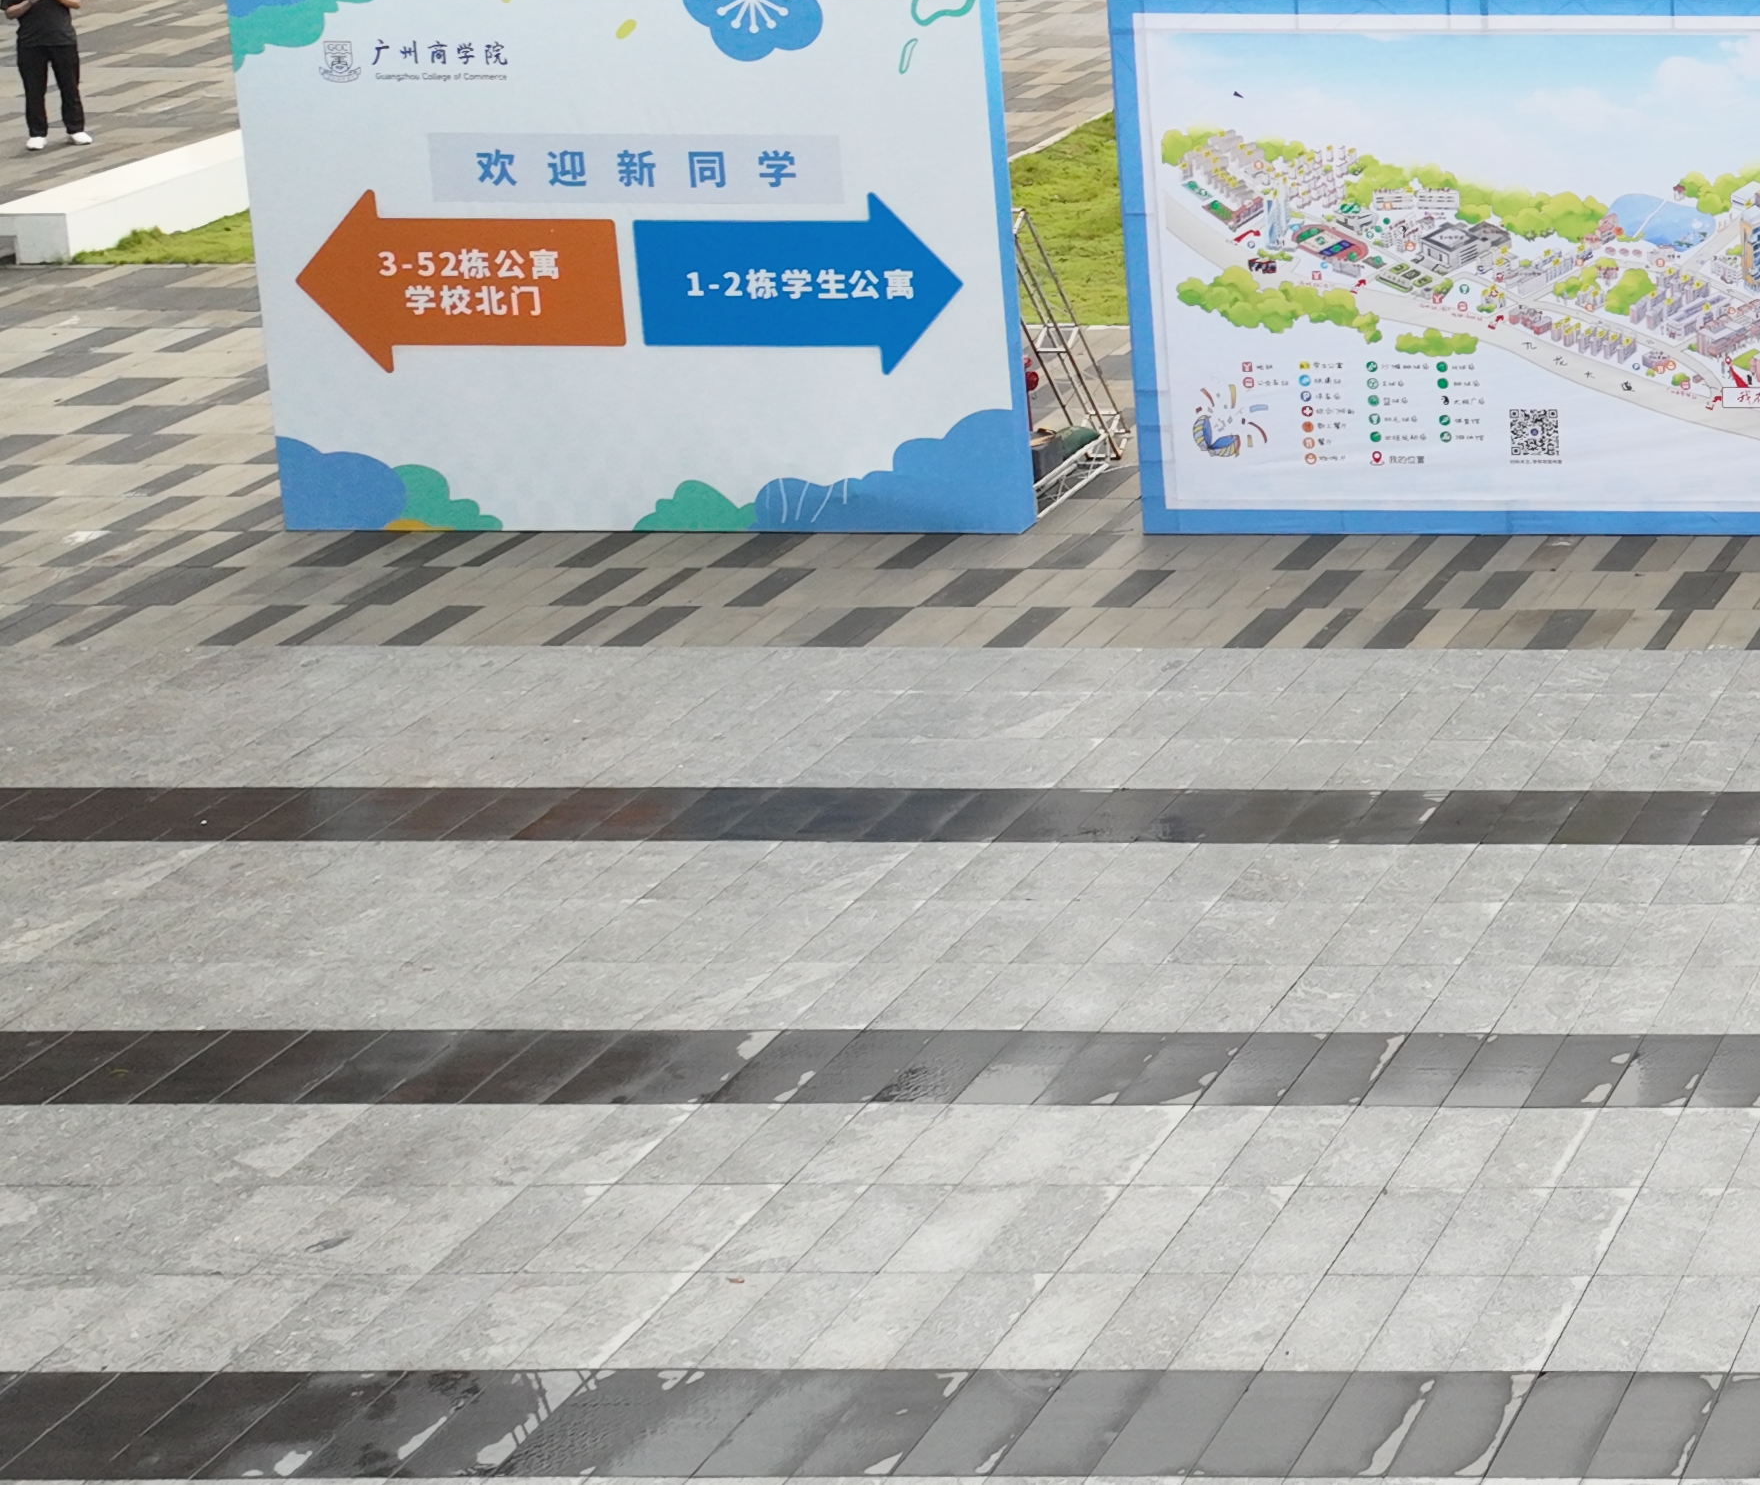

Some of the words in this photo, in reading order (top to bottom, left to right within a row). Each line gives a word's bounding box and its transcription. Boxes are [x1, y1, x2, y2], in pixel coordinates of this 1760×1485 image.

[371, 38, 509, 66] 广州商学院
[476, 148, 798, 189] 欢迎新同学
[377, 248, 561, 280] 3-52栋公寓
[404, 283, 543, 318] 学校北门
[685, 267, 916, 301] 1-2栋学生公寓
